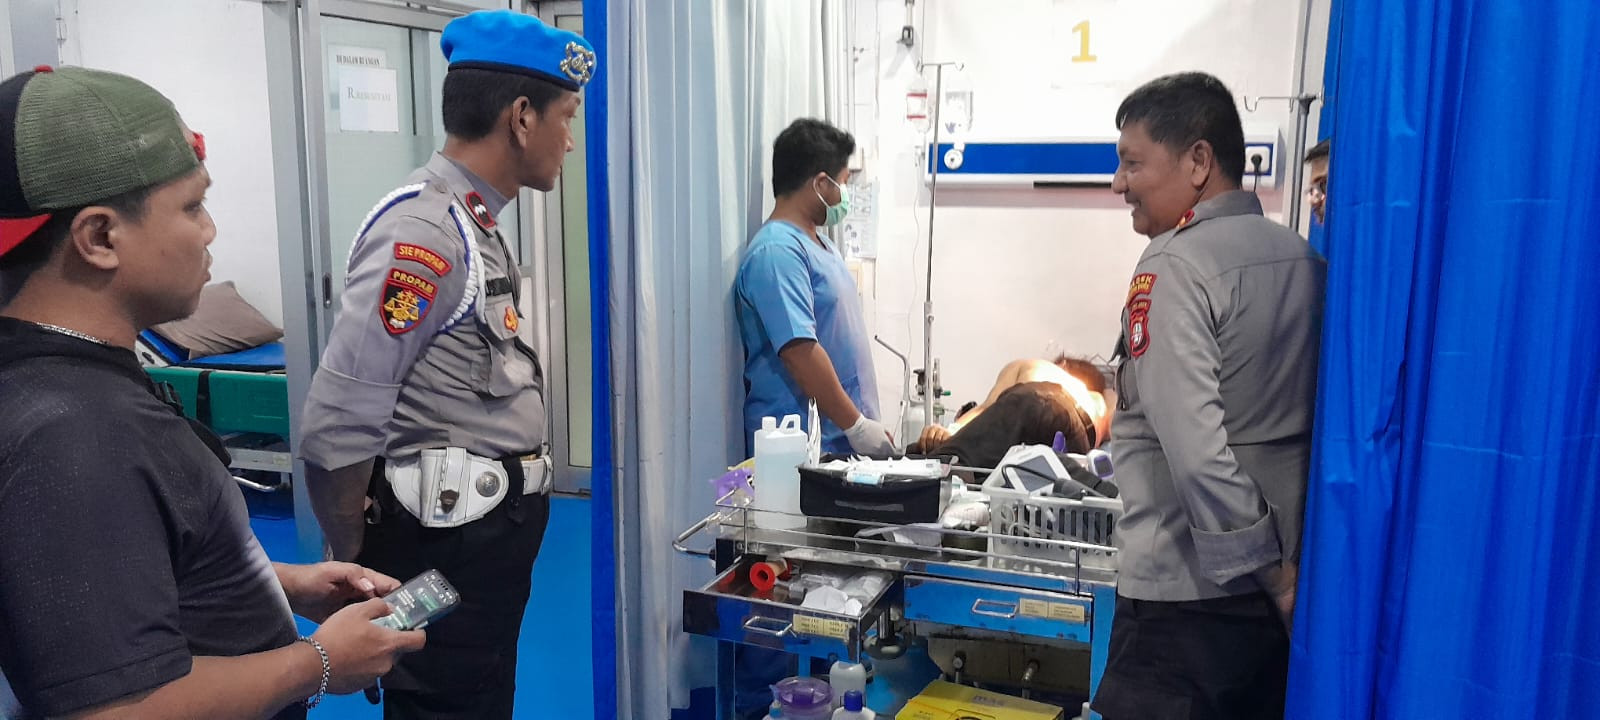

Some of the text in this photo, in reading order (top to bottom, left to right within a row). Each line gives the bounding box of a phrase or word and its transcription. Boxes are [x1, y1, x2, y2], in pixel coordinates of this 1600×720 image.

[1071, 20, 1097, 62] 1
[399, 245, 446, 271] SIE PROPAM
[393, 271, 434, 293] PROPAM
